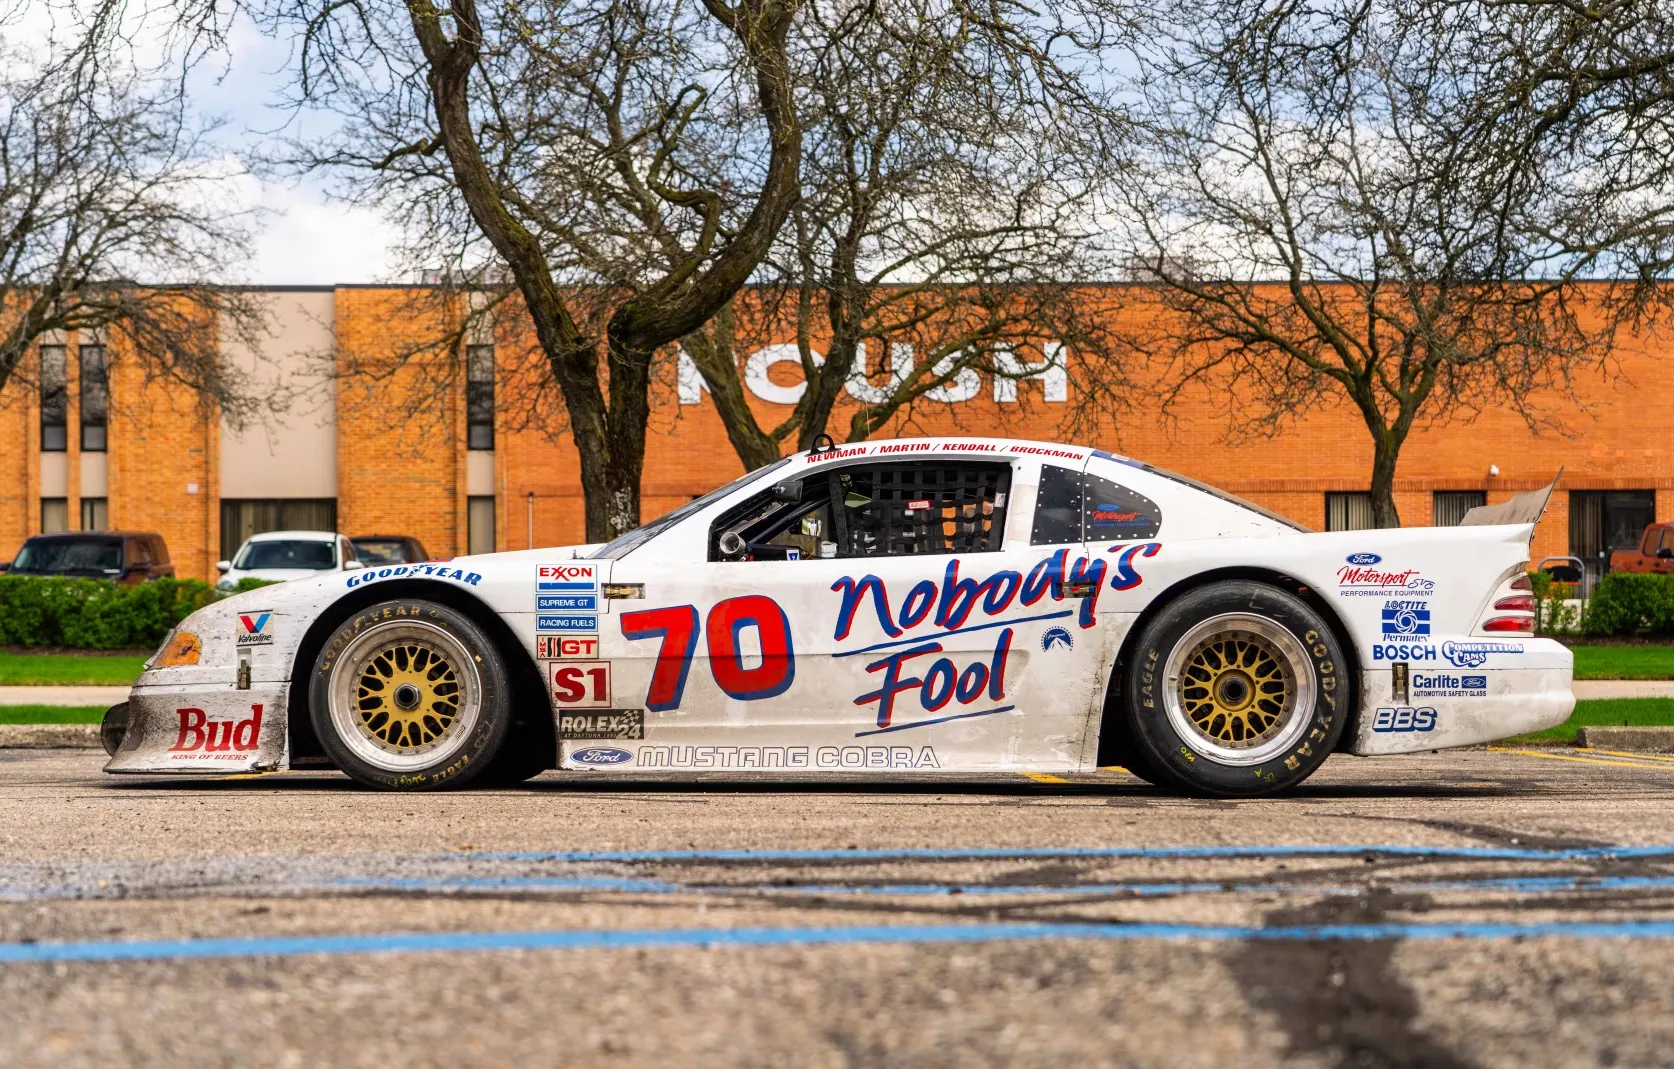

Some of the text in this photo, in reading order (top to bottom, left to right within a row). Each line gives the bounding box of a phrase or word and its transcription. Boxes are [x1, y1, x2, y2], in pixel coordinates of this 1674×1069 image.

[807, 447, 866, 463] NEWMAN
[879, 443, 930, 453] MARTIN
[942, 443, 996, 451] KENDALL
[1010, 445, 1083, 460] BROCKMAN
[346, 565, 482, 588] GOODYEAR
[539, 566, 592, 581] EXXON
[1337, 566, 1420, 588] Motorsport
[1384, 600, 1427, 610] LOCTITE
[237, 633, 272, 643] Valvoline
[561, 640, 597, 655] GT
[620, 595, 795, 712] 70
[1373, 644, 1436, 660] BOSCH
[555, 667, 607, 703] S1
[853, 628, 1013, 727] Fool
[1143, 649, 1160, 709] EAGLE
[1413, 675, 1459, 688] Carlite
[168, 704, 263, 752] Bud
[561, 716, 641, 740] ROLEX 24
[1372, 707, 1438, 732] BBS
[636, 745, 808, 767] MUSTANG
[815, 745, 941, 768] COBRA
